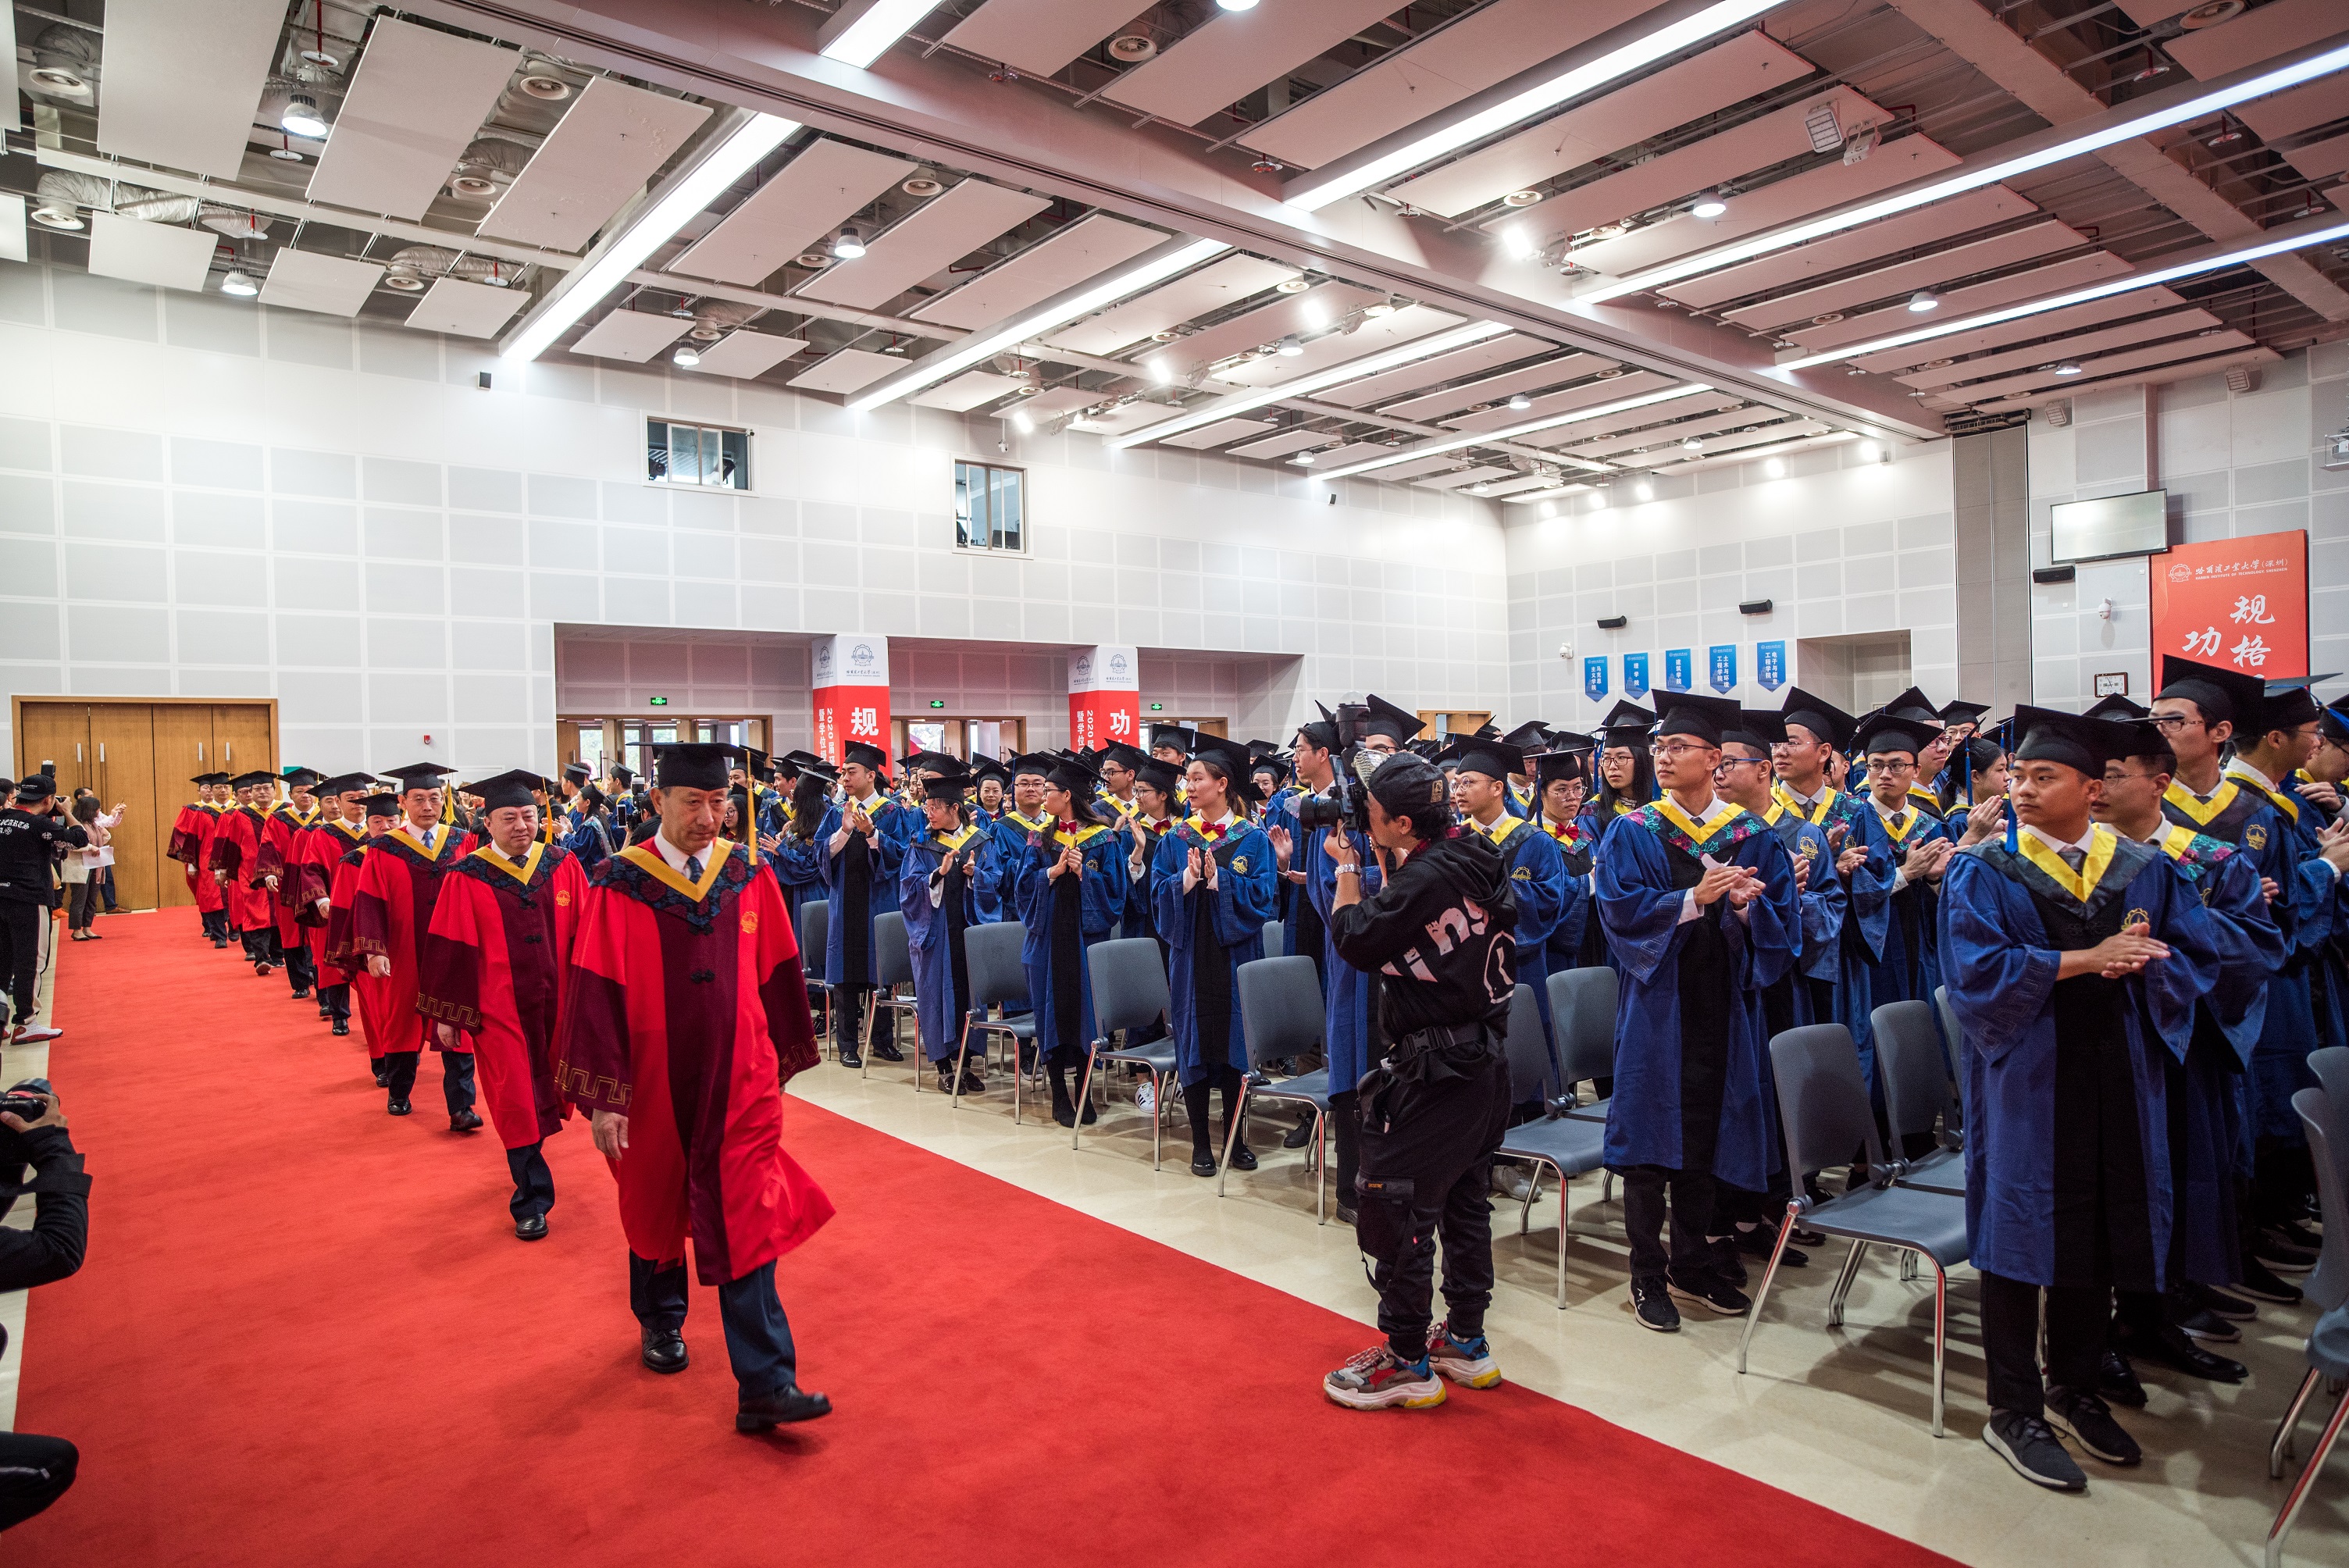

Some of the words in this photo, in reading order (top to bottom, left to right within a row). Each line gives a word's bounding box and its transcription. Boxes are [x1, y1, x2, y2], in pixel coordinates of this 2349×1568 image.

[2182, 626, 2222, 657] 功
[2230, 594, 2276, 679] 规格
[850, 707, 879, 747] 规
[1110, 709, 1130, 745] 功
